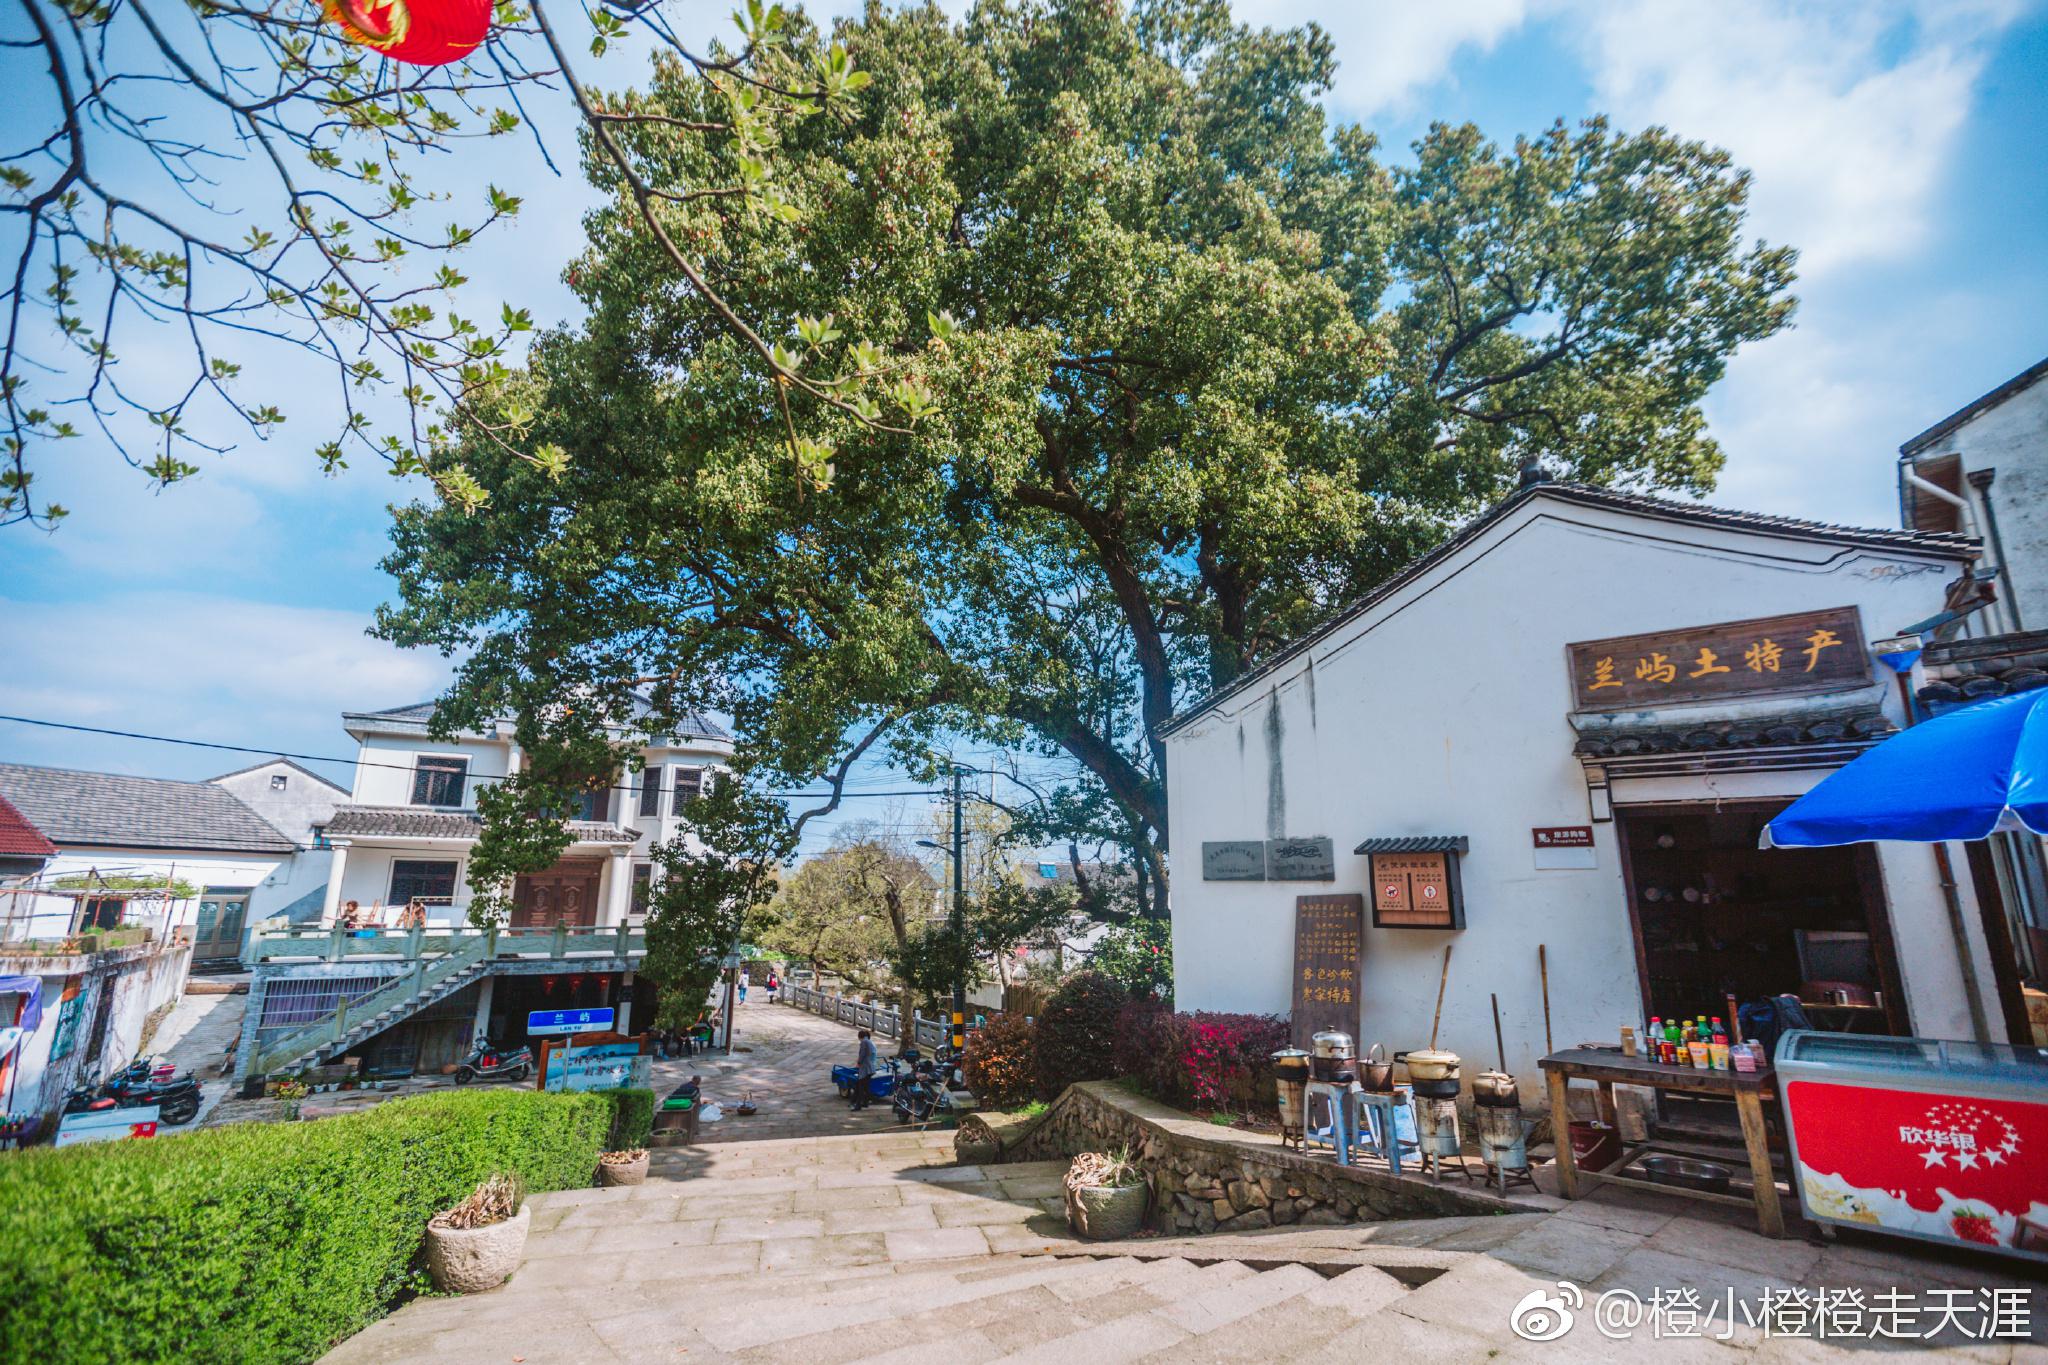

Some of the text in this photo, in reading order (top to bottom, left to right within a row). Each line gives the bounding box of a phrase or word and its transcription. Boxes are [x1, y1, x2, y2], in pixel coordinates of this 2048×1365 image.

[1588, 629, 1843, 691] 兰屿土特产
[553, 1012, 590, 1024] 兰屿
